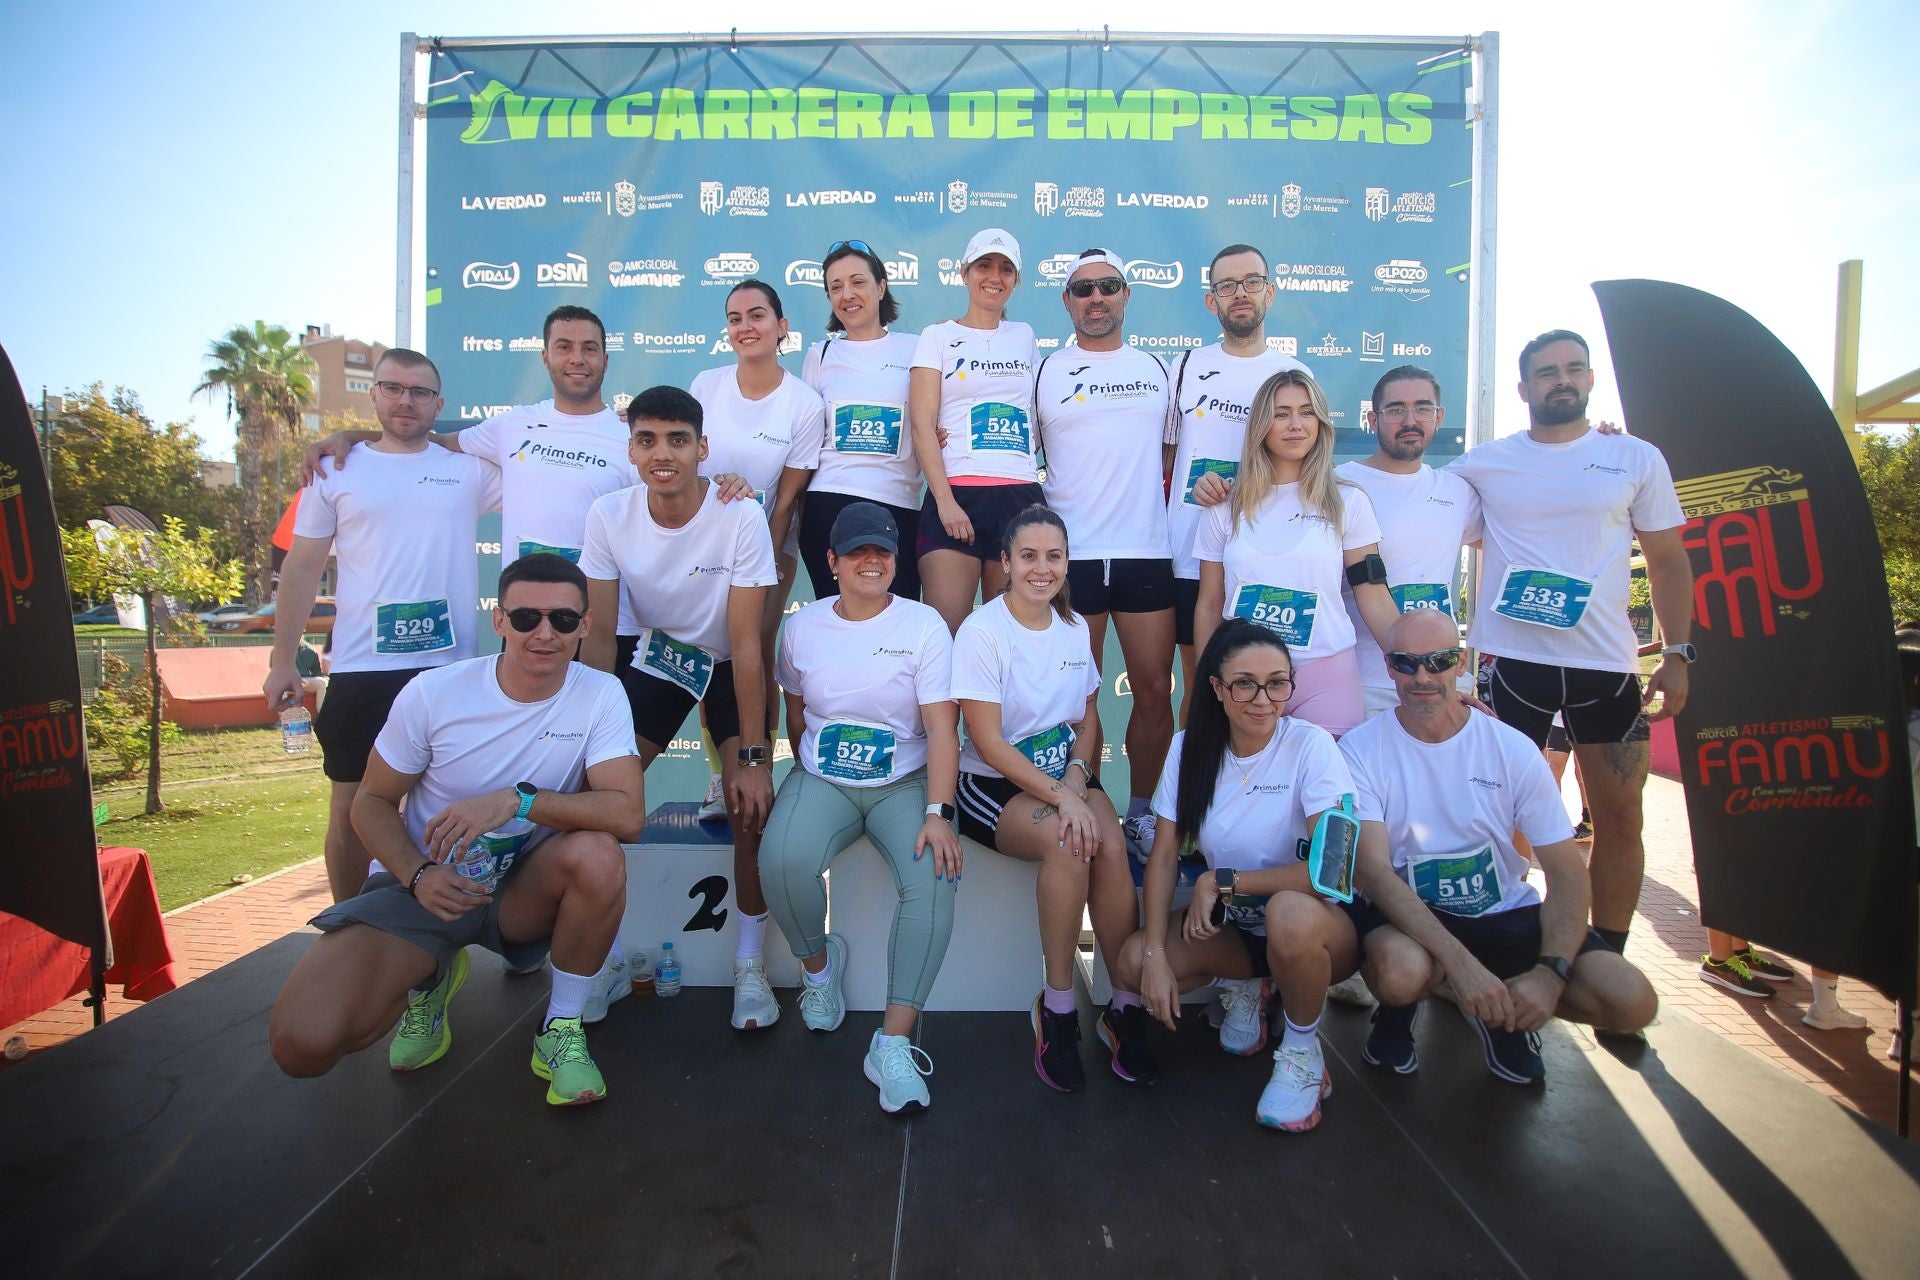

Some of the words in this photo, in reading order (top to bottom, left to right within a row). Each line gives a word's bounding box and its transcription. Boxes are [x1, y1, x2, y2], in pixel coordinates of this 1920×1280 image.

[606, 87, 935, 141] CARRERA
[949, 88, 1035, 140] DE
[1047, 87, 1432, 146] EMPRESAS
[638, 192, 684, 203] Ayuntamiento
[731, 188, 770, 199] murcia
[786, 193, 809, 207] LA
[809, 191, 876, 206] VERDAD
[970, 190, 1018, 201] Ayuntamiento
[1066, 190, 1105, 200] murcia
[1117, 193, 1138, 207] LA
[1141, 194, 1209, 209] VERDAD
[1303, 195, 1349, 206] Ayuntamiento
[1397, 195, 1435, 206] murcia
[462, 196, 487, 211] LA
[486, 193, 547, 210] VERDAD
[638, 202, 647, 210] de
[648, 201, 673, 209] Murcia
[725, 198, 770, 208] ATLETISMO
[970, 199, 979, 207] de
[980, 199, 1007, 208] Murcia
[1061, 199, 1105, 208] ATLETISMO
[1303, 203, 1312, 211] de
[1313, 204, 1339, 212] Murcia
[1391, 205, 1435, 214] ATLETISMO
[471, 270, 512, 282] VIDAL
[537, 263, 588, 282] DSM
[795, 268, 824, 280] VIDA
[886, 262, 919, 280] SM
[1131, 268, 1175, 281] VIDAL
[633, 332, 706, 345] Brocalsa
[1128, 334, 1202, 348] Brocalsa
[1307, 346, 1353, 354] ESTRELLA
[1392, 343, 1432, 356] Hero
[1090, 380, 1159, 395] PrimaFrio
[460, 406, 484, 419] LA
[1210, 399, 1250, 415] Prima
[1220, 411, 1249, 422] Fundac
[850, 419, 886, 436] 523
[988, 417, 1020, 435] 524
[531, 444, 607, 468] PrimaFrio
[1740, 493, 1792, 509] 2025
[1521, 586, 1567, 608] 533
[1252, 602, 1296, 625] 520
[394, 617, 435, 636] 529
[663, 645, 695, 673] 514
[1741, 717, 1830, 737] ATLETISMO
[837, 741, 877, 763] 527
[1034, 742, 1068, 768] 526
[1697, 731, 1891, 786] FAMU
[1724, 785, 1875, 816] Corriendo
[1438, 873, 1484, 898] 519
[682, 875, 729, 933] 2
